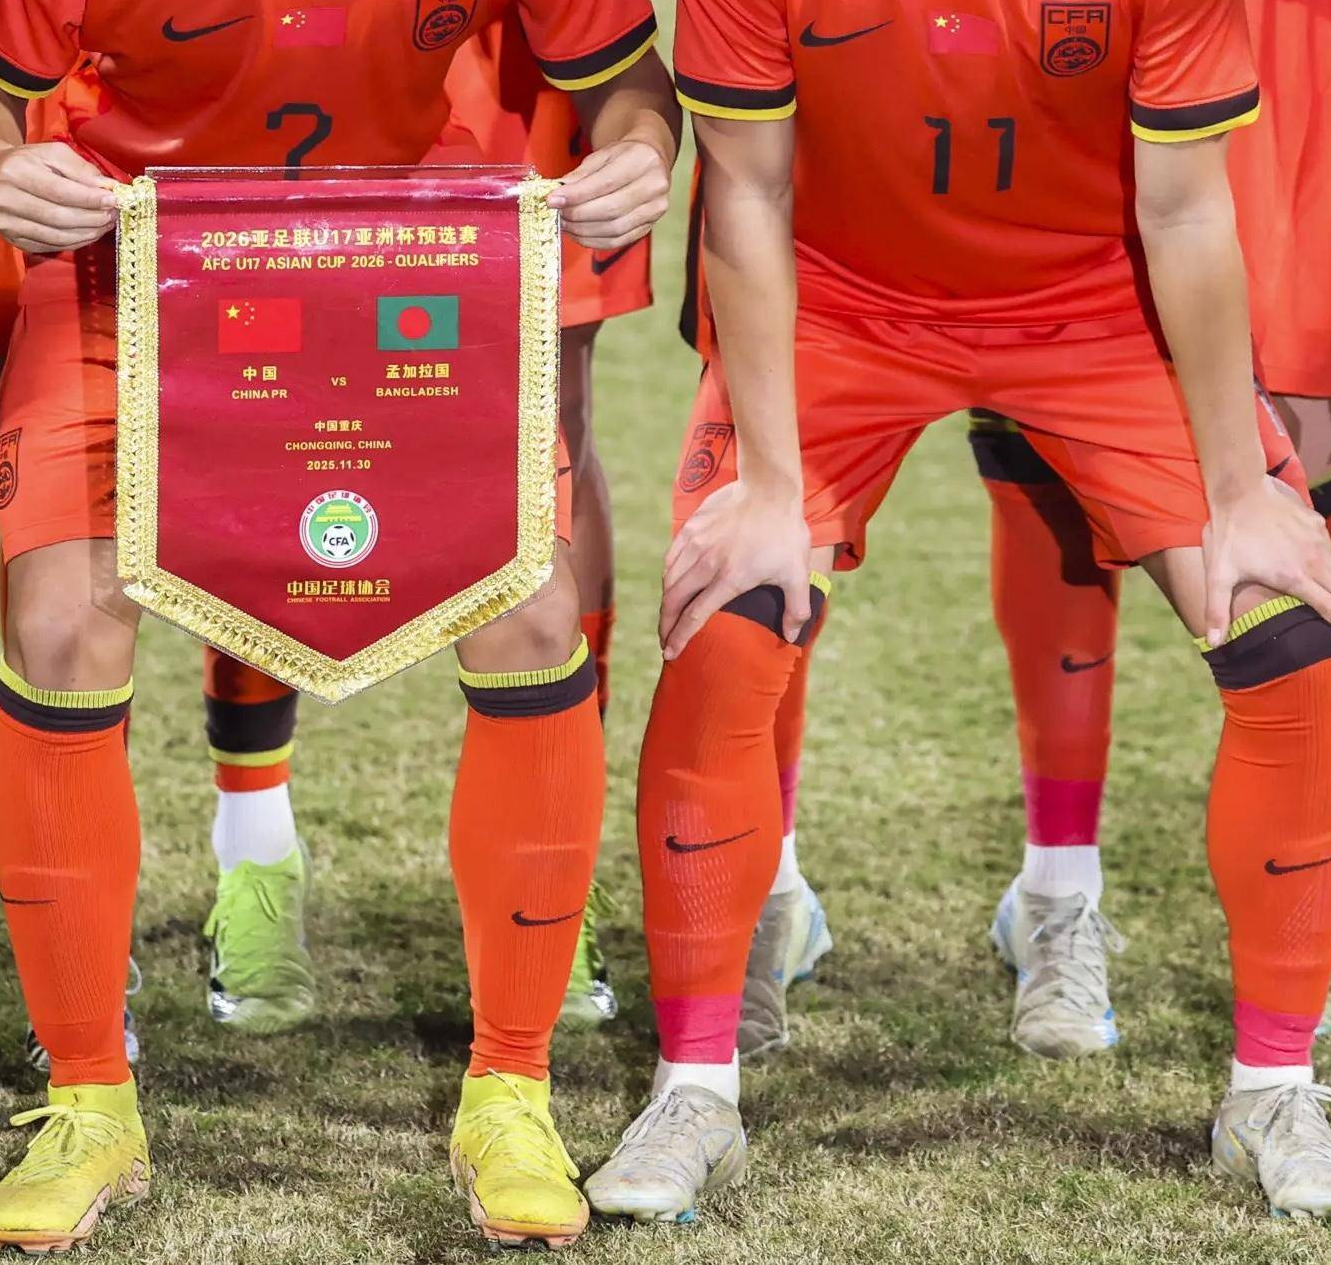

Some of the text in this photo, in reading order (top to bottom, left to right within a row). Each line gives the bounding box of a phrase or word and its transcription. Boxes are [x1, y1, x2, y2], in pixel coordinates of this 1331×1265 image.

[1048, 9, 1104, 24] CFA
[925, 116, 1014, 194] 11
[201, 226, 479, 248] 2026亚足联U17亚洲杯预选赛
[202, 257, 231, 271] AFC
[236, 257, 260, 270] U17
[266, 256, 312, 269] ASIAN
[317, 255, 346, 268] CUP
[243, 366, 277, 381] 中国
[386, 363, 450, 379] 孟加拉国
[331, 377, 347, 386] VS
[231, 389, 288, 400] CHINA PR
[376, 386, 459, 397] BANGLADESH
[314, 420, 363, 432] 中国重庆
[358, 440, 392, 450] CHINA
[306, 459, 371, 471] 2025.11.30
[329, 536, 350, 547] CFA
[287, 578, 391, 596] 中国足球协会
